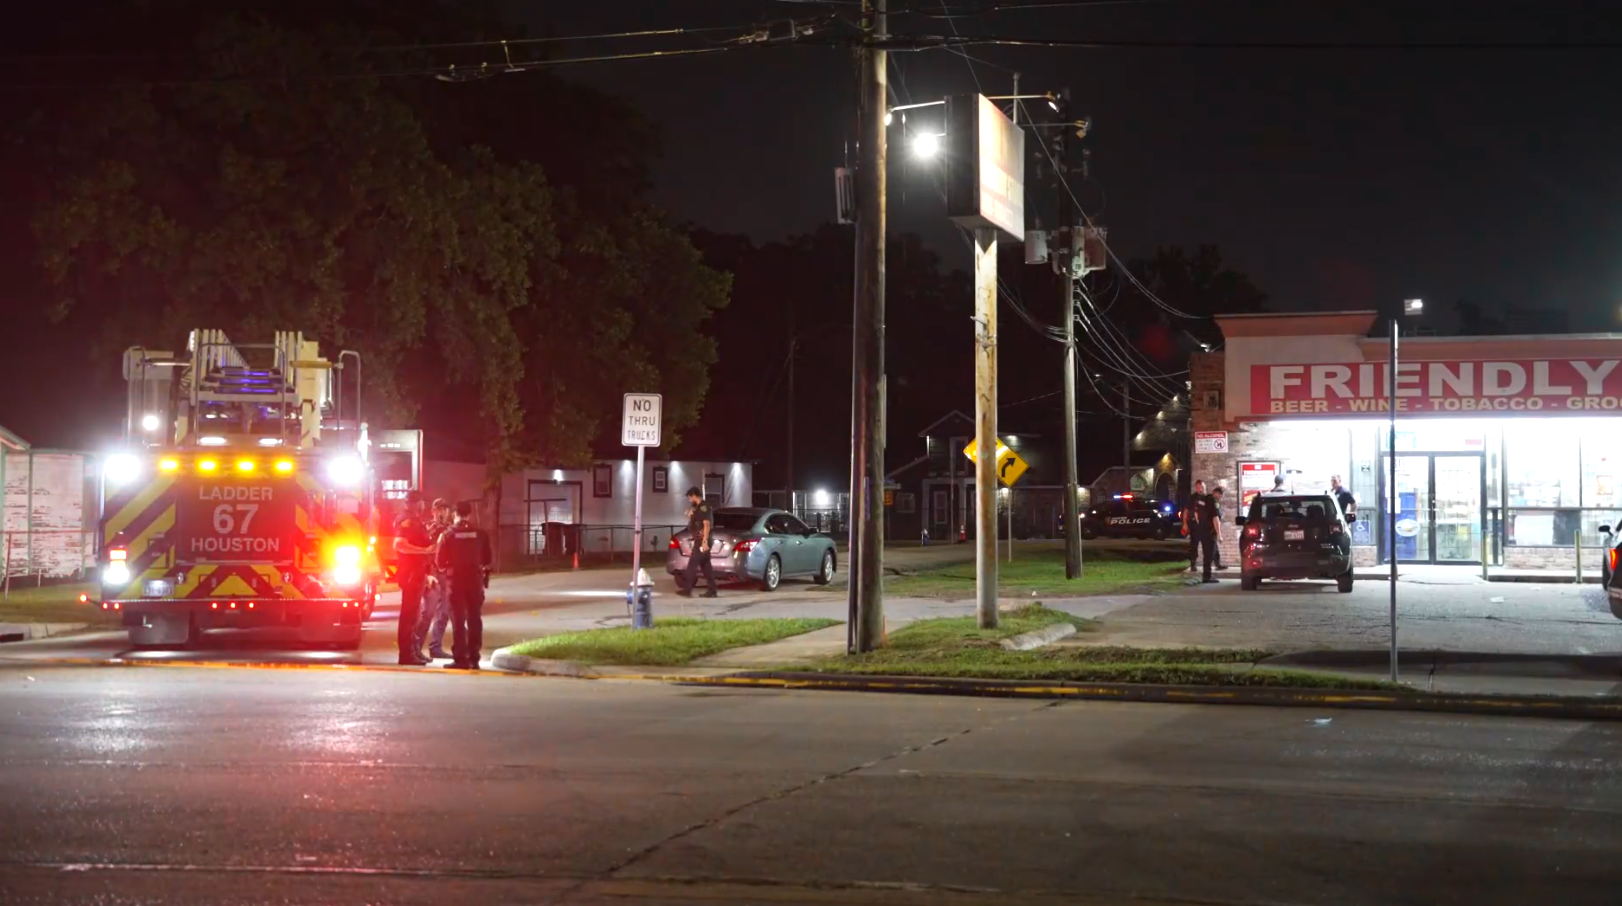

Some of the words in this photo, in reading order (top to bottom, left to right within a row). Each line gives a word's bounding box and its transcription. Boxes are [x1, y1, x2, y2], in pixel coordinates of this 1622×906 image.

[1270, 360, 1621, 399] FRIENDLY
[633, 400, 651, 411] NO
[1270, 400, 1329, 413] BEER
[1349, 399, 1408, 412] WINE
[1429, 398, 1543, 411] TOBACCO
[1566, 396, 1622, 410] GRO
[628, 416, 656, 426] THRU
[627, 430, 656, 440] TRUCKS
[199, 485, 273, 500] LADDER
[213, 504, 259, 534] 67
[1110, 517, 1151, 525] POLICE
[191, 537, 279, 552] HOUSTON
